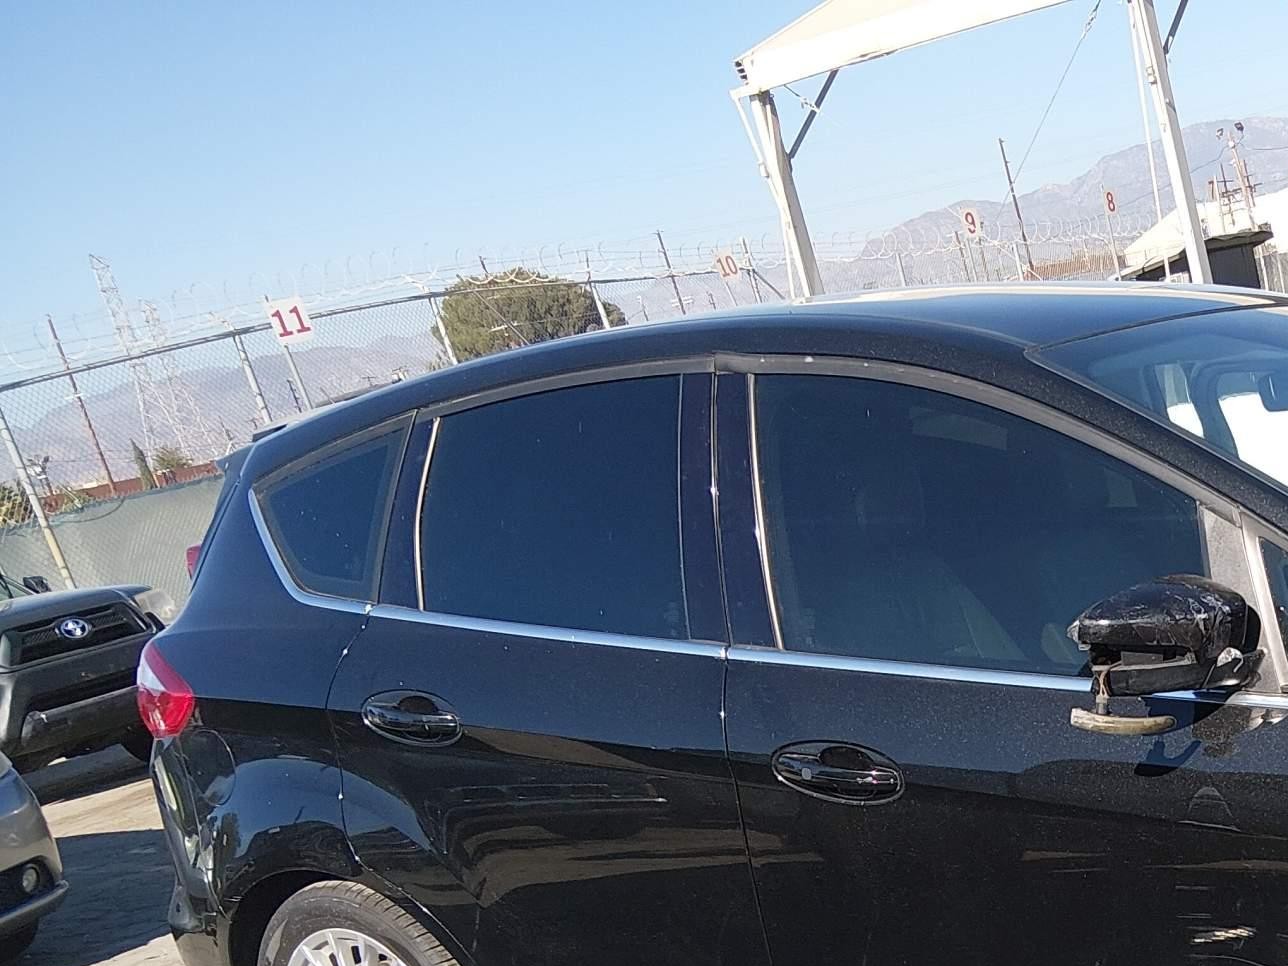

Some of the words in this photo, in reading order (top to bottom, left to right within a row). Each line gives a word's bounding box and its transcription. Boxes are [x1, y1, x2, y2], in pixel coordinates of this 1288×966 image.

[1106, 191, 1116, 212] 8
[964, 211, 977, 234] 9
[716, 255, 738, 278] 10
[271, 305, 311, 337] 11
